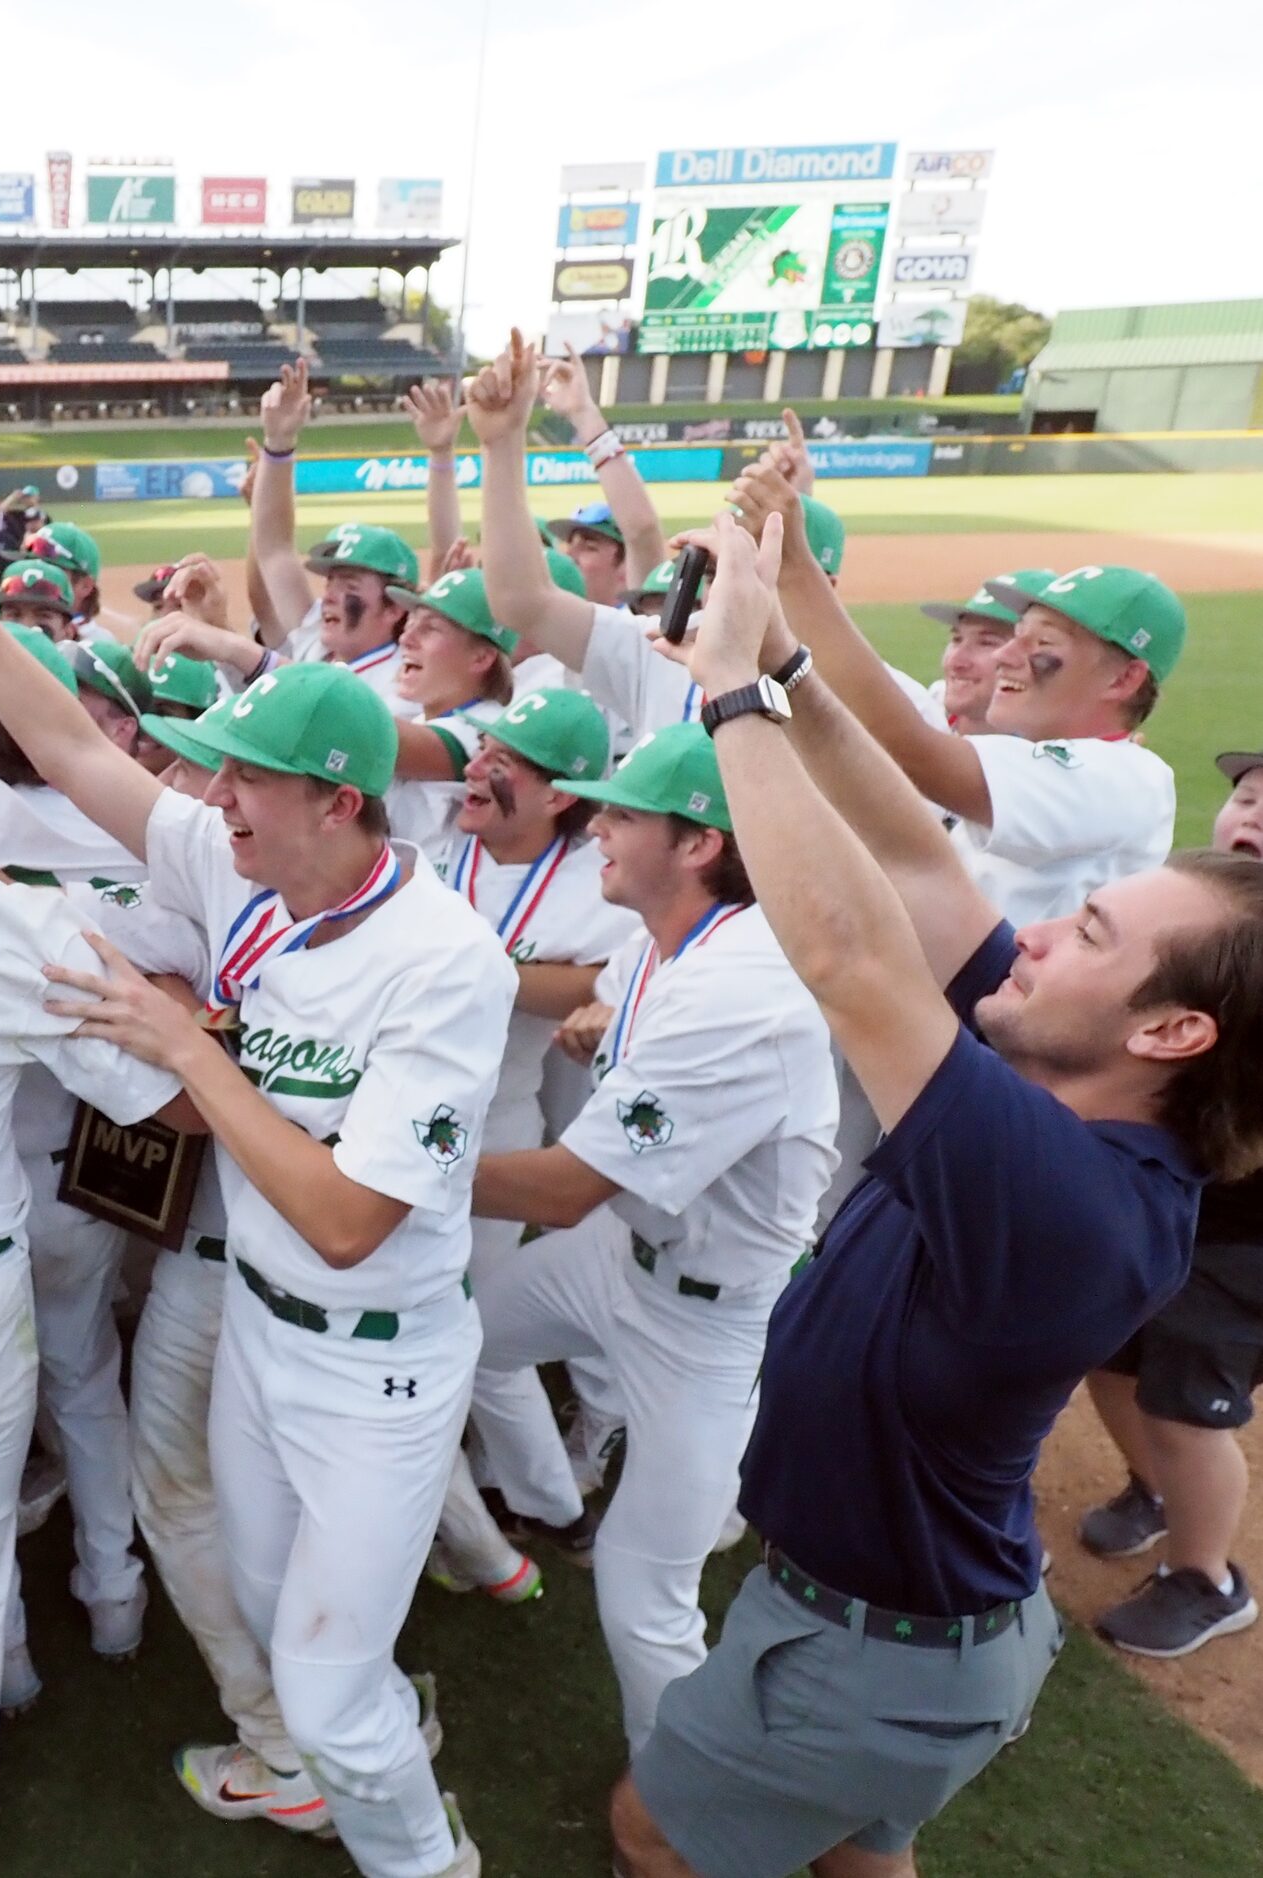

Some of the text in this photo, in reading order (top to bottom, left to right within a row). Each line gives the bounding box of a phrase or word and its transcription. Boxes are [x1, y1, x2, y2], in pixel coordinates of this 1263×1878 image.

[671, 143, 883, 182] Dell Diamond
[430, 571, 466, 598] C
[1048, 565, 1104, 593] C
[233, 673, 279, 719] C
[505, 693, 548, 724] C
[93, 1119, 167, 1170] MVP
